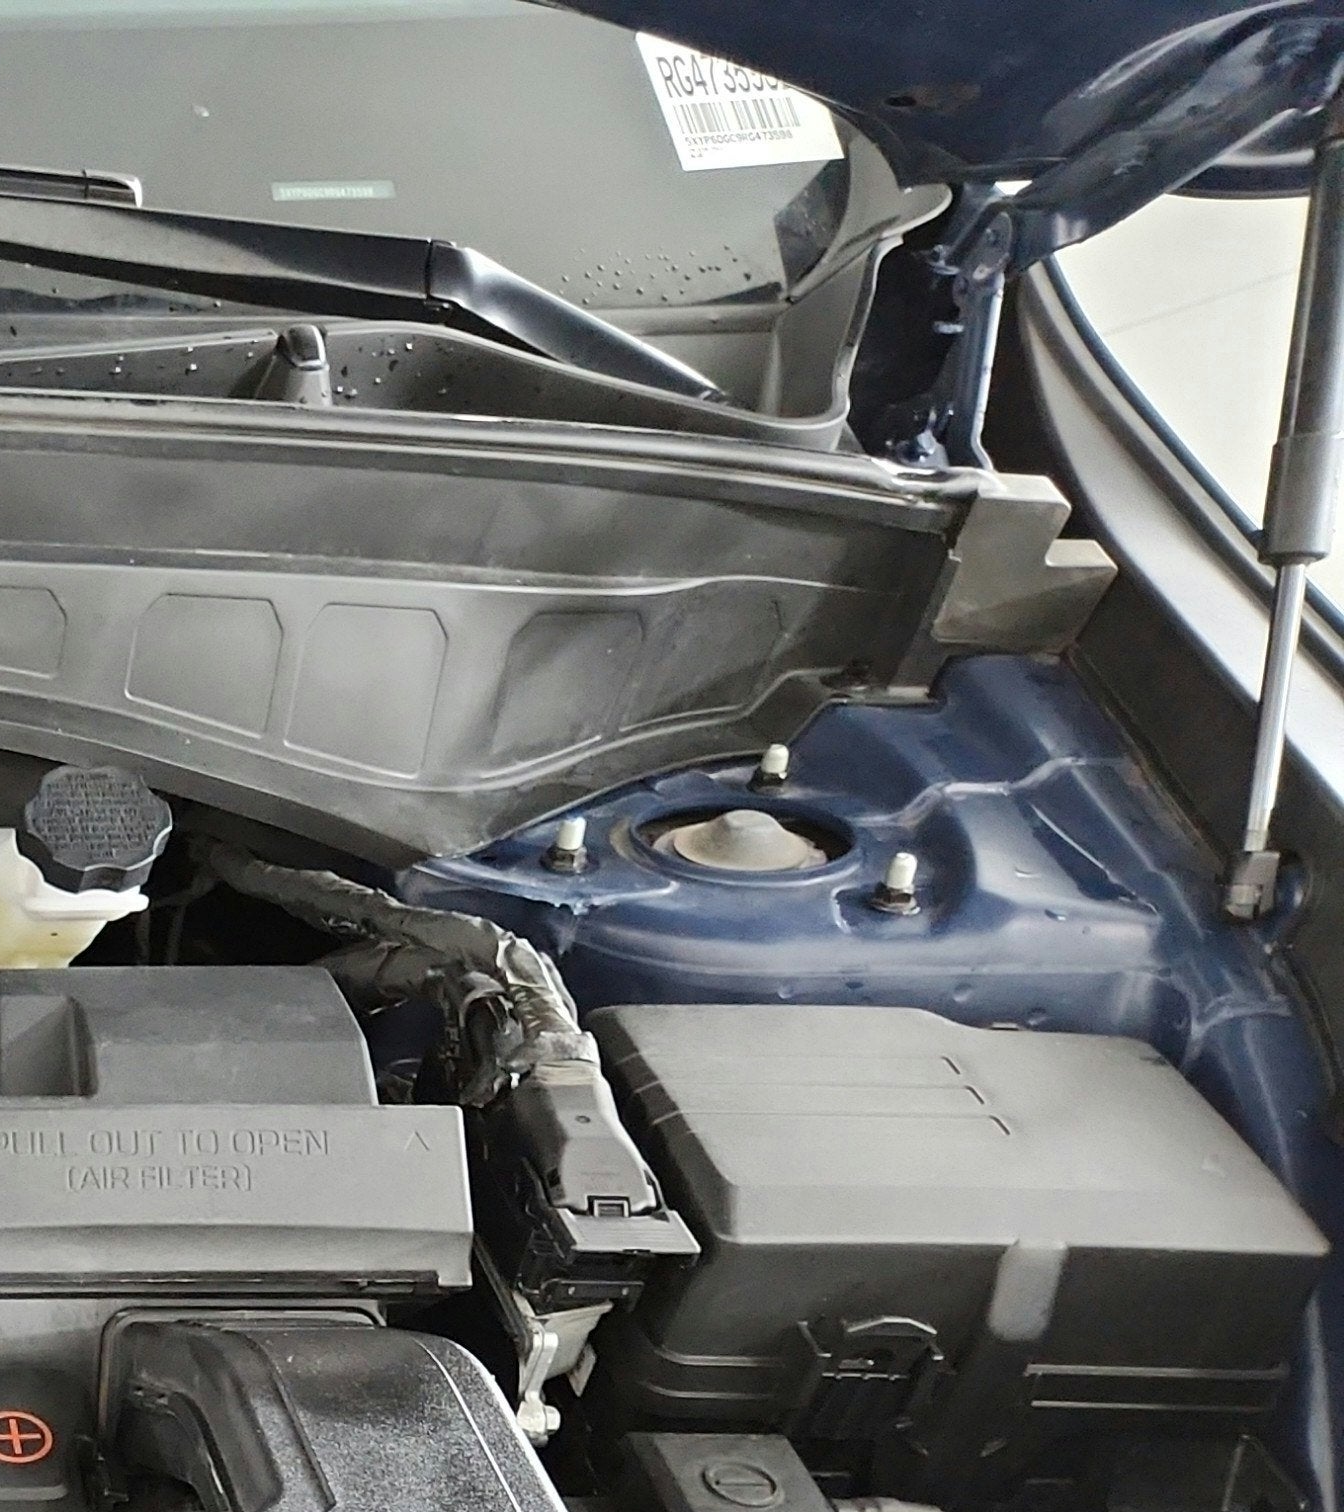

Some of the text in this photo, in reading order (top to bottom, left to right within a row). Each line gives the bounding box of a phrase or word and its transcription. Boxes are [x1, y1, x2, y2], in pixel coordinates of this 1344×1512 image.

[88, 1129, 163, 1156] OUT
[173, 1129, 221, 1155] TO
[231, 1129, 329, 1156] OPEN
[67, 1164, 253, 1192] (AIR FILTER)
